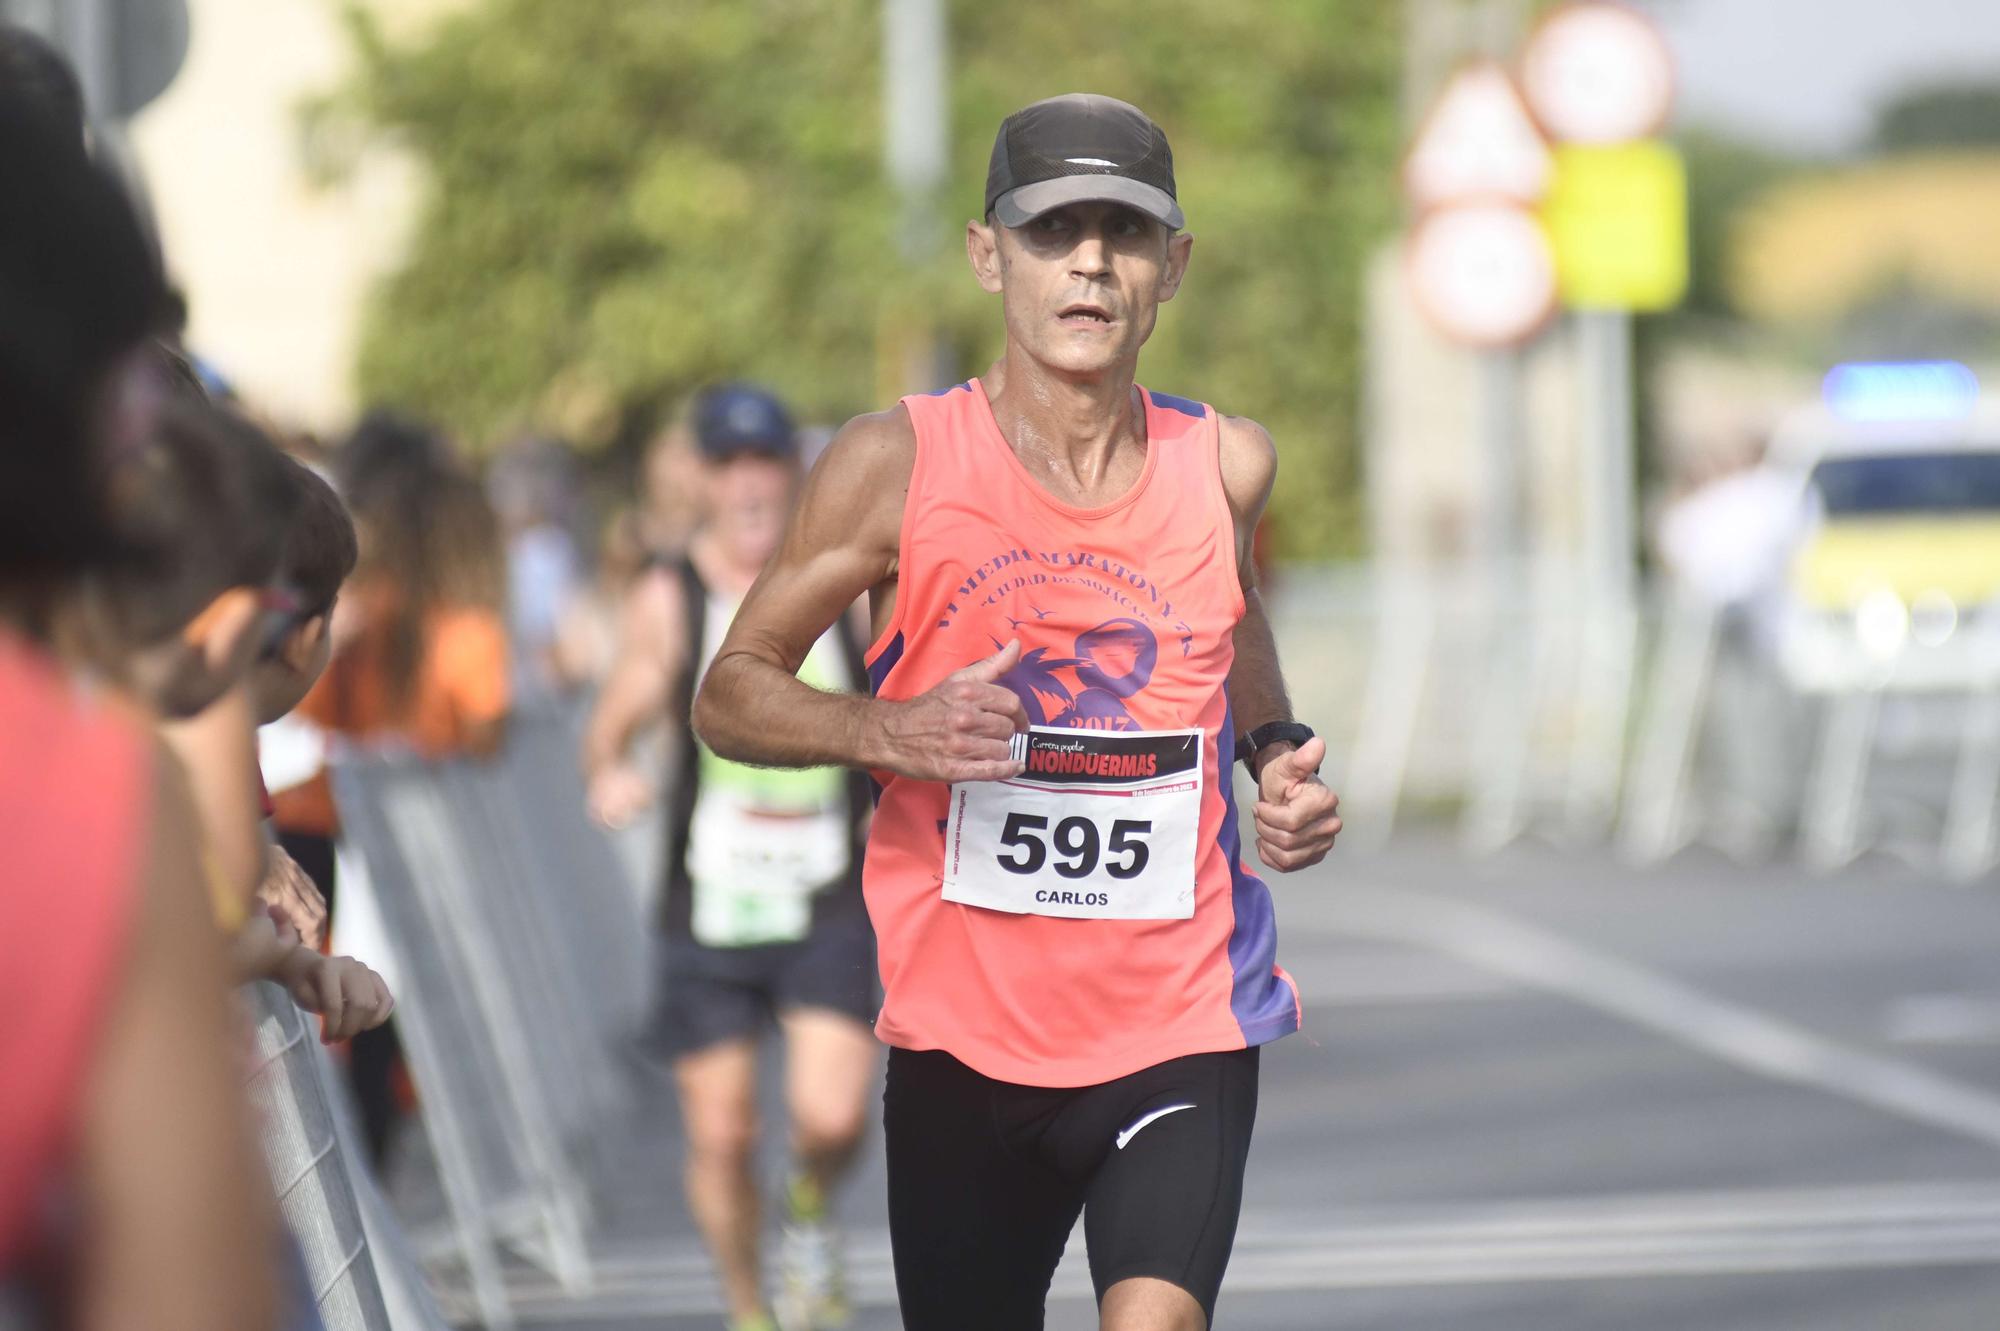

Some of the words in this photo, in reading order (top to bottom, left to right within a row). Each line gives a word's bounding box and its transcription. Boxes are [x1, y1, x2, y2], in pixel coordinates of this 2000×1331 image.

[957, 548, 1033, 599] MEDIA
[1069, 715, 1131, 731] 2017
[1031, 737, 1059, 751] Carrera
[1029, 748, 1157, 777] NONDUERMAS
[996, 811, 1153, 880] 595
[1035, 890, 1109, 906] CARLOS
